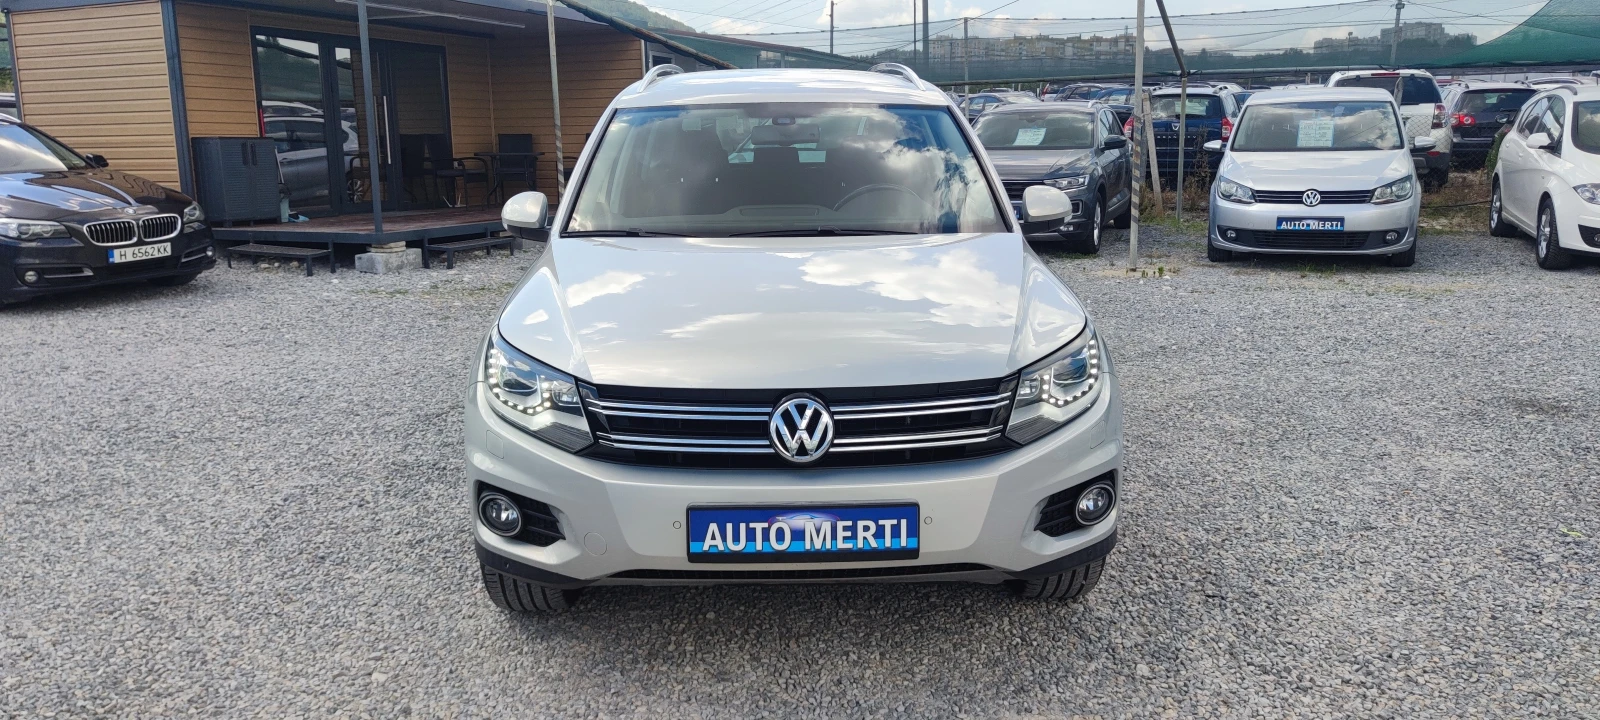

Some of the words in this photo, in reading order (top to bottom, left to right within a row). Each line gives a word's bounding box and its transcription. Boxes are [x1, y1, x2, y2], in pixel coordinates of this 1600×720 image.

[1280, 221, 1307, 230] AUTO
[1309, 221, 1341, 230] MERTI
[119, 250, 127, 261] H
[702, 521, 793, 552] AUTO
[804, 518, 908, 551] MERTI
